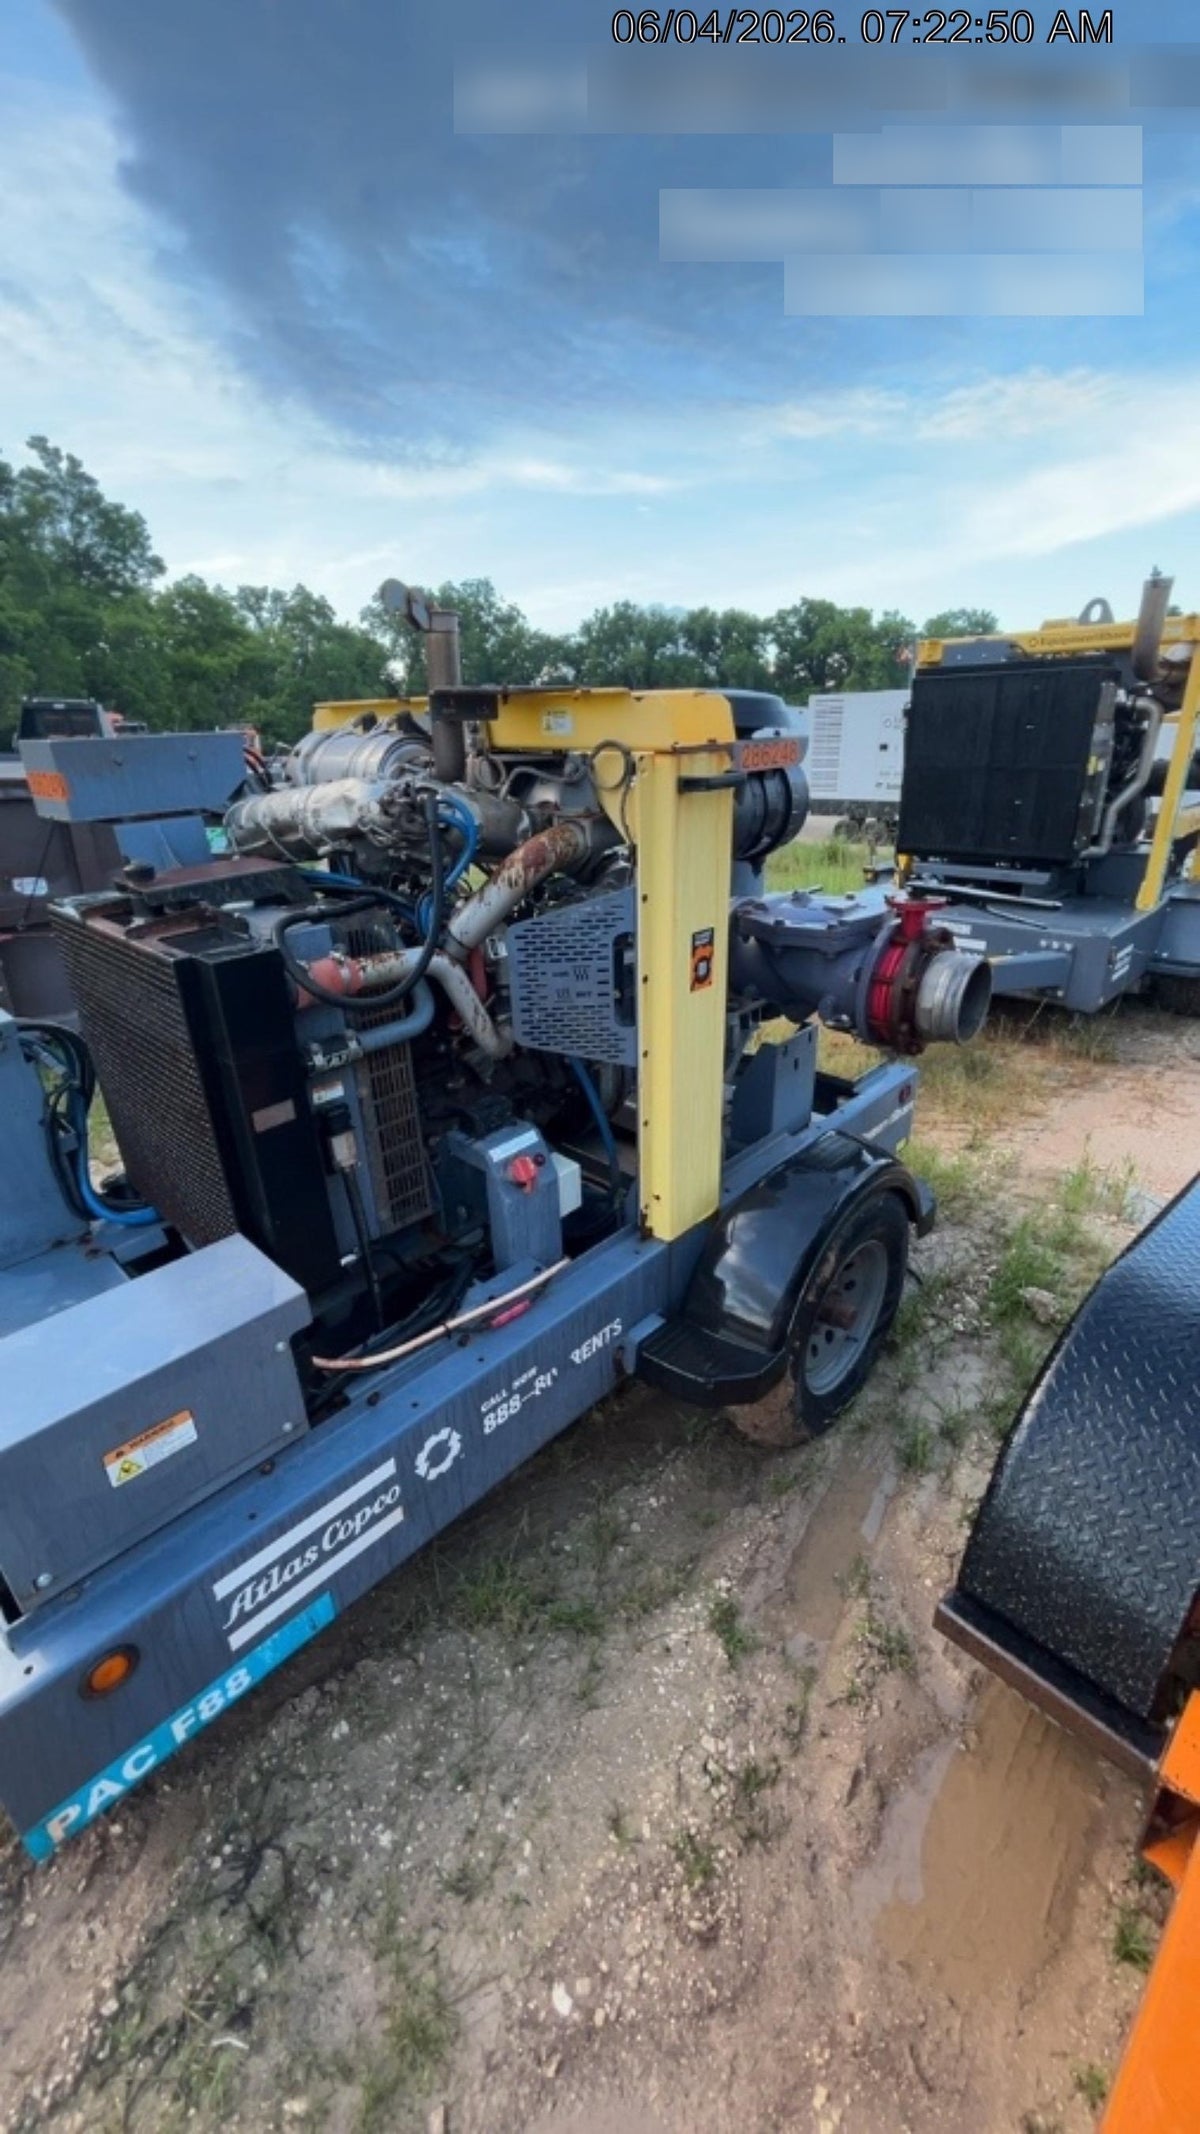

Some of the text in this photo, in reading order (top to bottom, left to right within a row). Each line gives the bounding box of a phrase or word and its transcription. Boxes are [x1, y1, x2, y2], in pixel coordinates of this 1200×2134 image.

[480, 1388, 508, 1413] CALL
[223, 1484, 401, 1630] Atlas Copco
[47, 1668, 252, 1842] PAC F88
